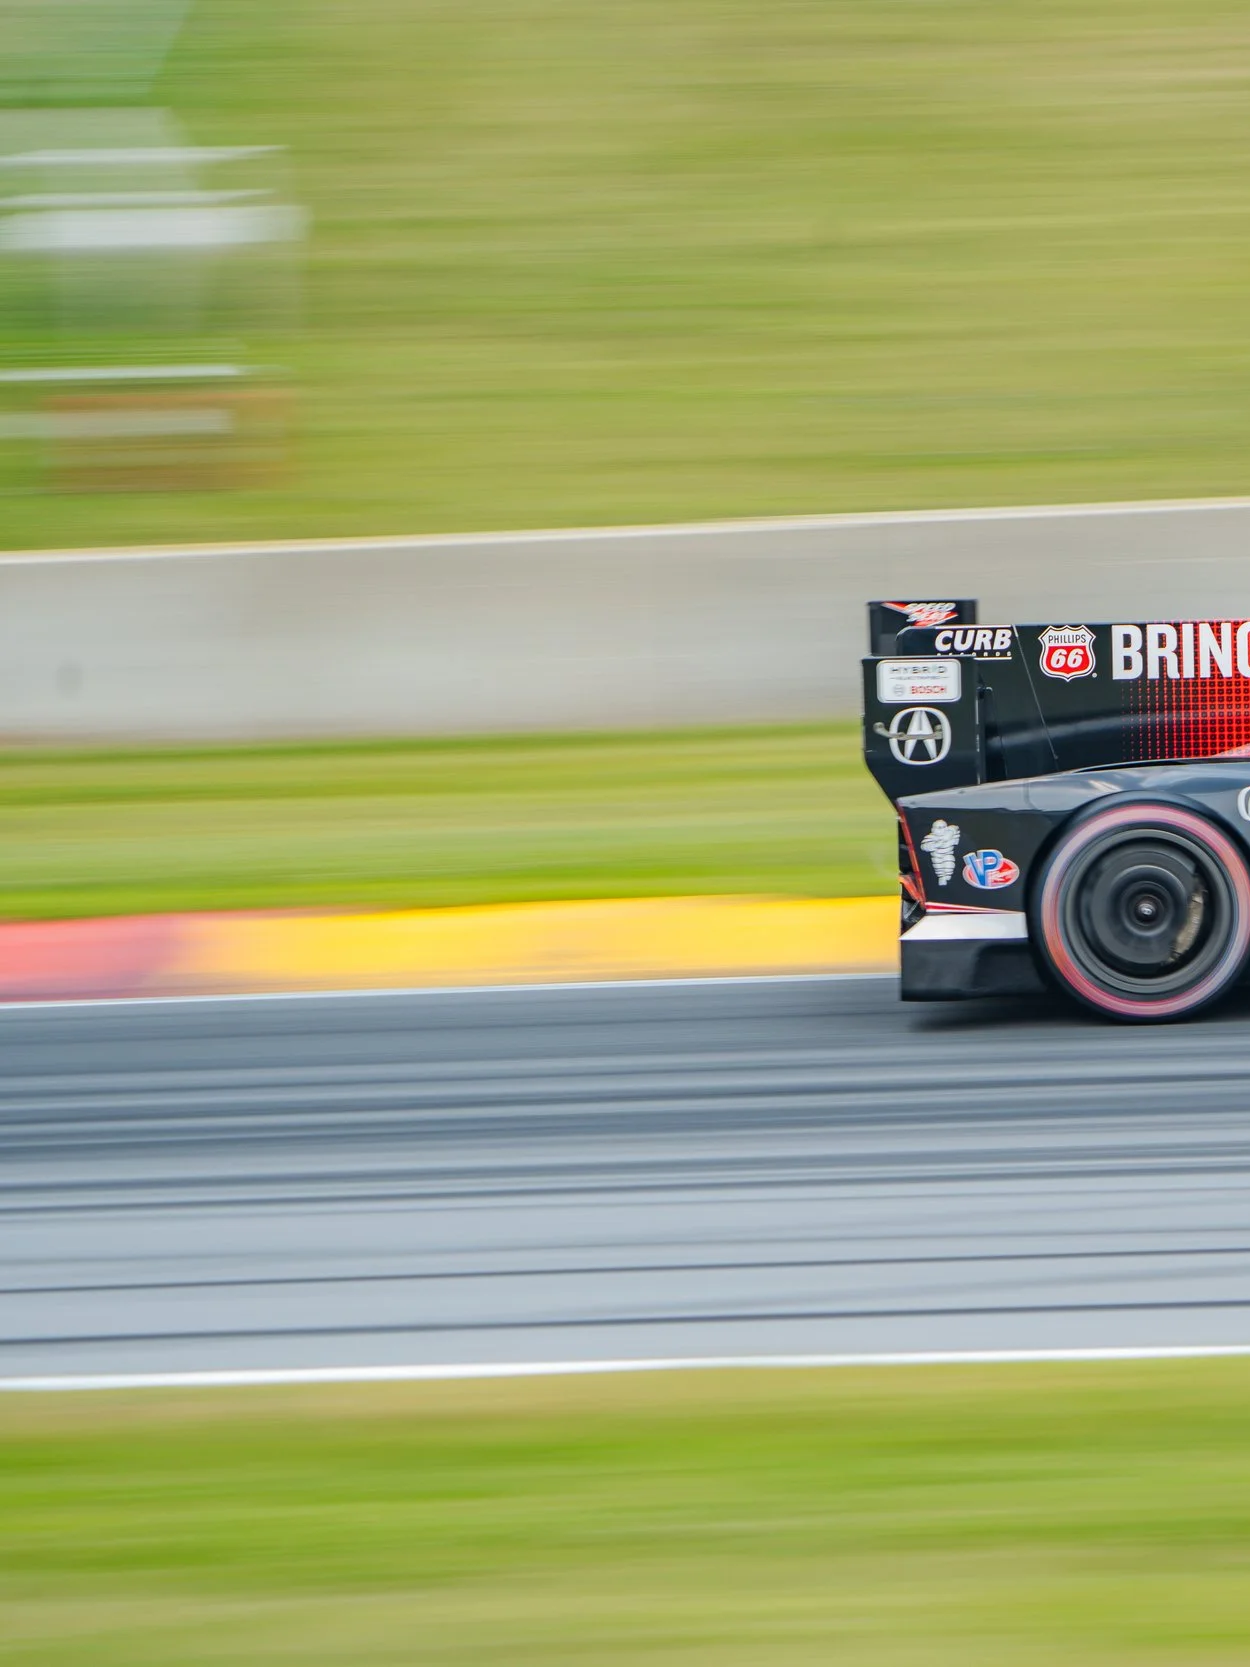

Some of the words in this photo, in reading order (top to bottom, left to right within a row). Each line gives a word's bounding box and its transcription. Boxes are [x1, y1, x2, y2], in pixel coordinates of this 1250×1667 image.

[935, 629, 1012, 651] CURB
[1048, 634, 1087, 644] PHILLIPS
[1050, 649, 1083, 668] 66
[890, 665, 947, 674] HYBRID
[911, 685, 947, 694] BOSCH
[963, 849, 1003, 887] VP
